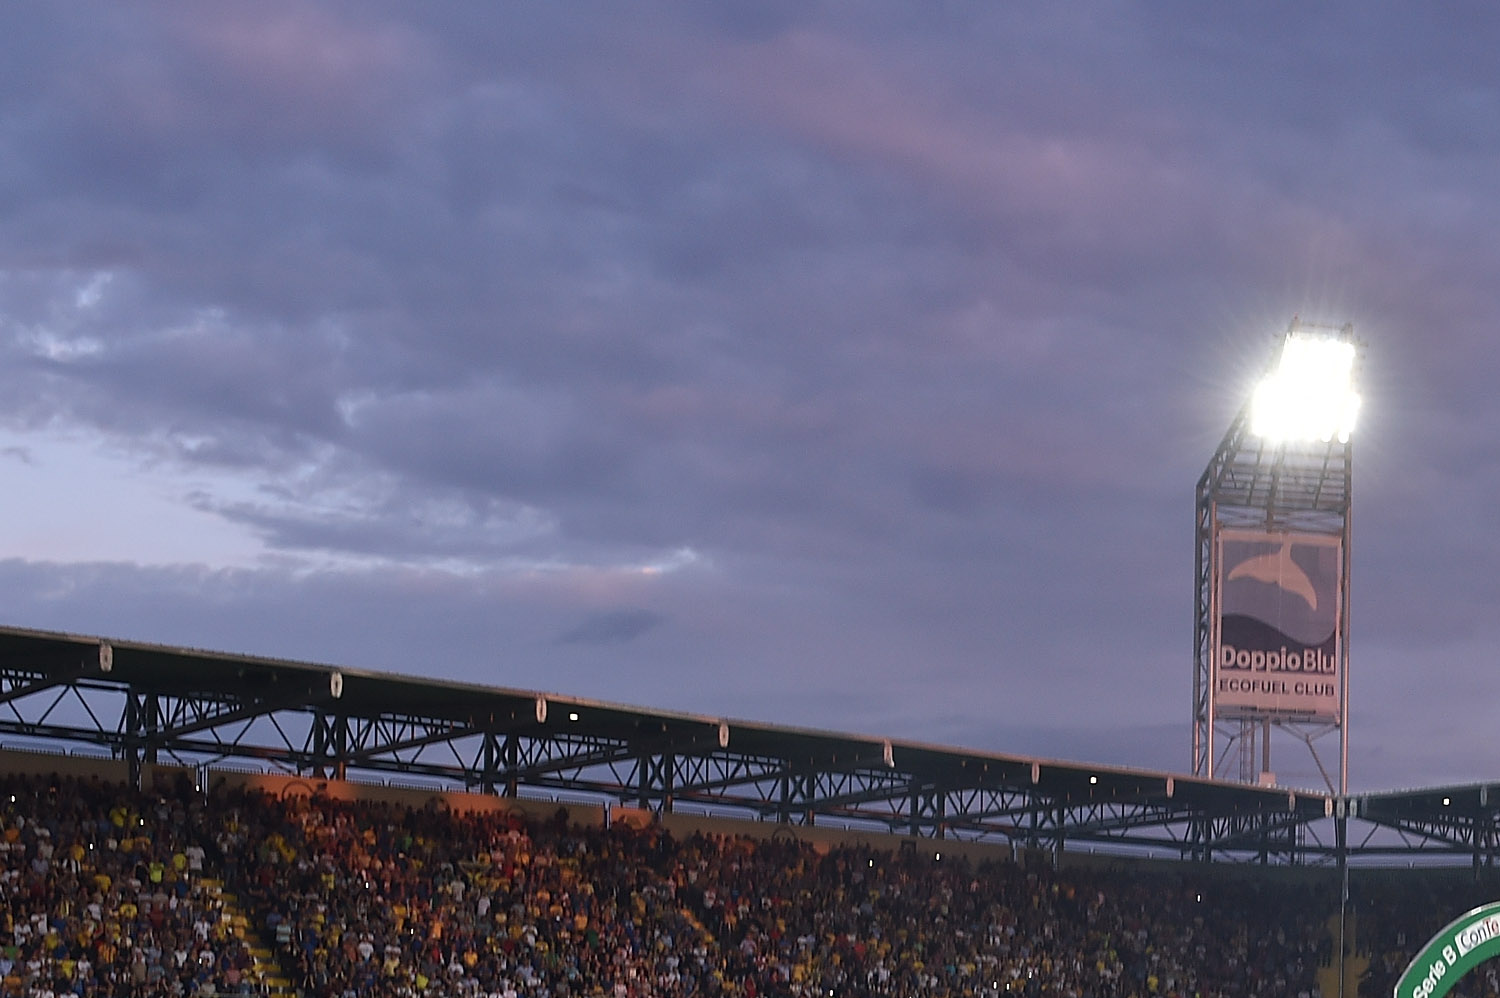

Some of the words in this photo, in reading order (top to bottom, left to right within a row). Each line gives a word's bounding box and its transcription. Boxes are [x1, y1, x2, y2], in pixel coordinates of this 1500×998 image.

[1220, 645, 1301, 674] Doppio
[1303, 647, 1335, 674] Blu
[1219, 679, 1290, 695] ECOFUEL
[1294, 681, 1335, 697] CLUB
[1442, 944, 1457, 966] B
